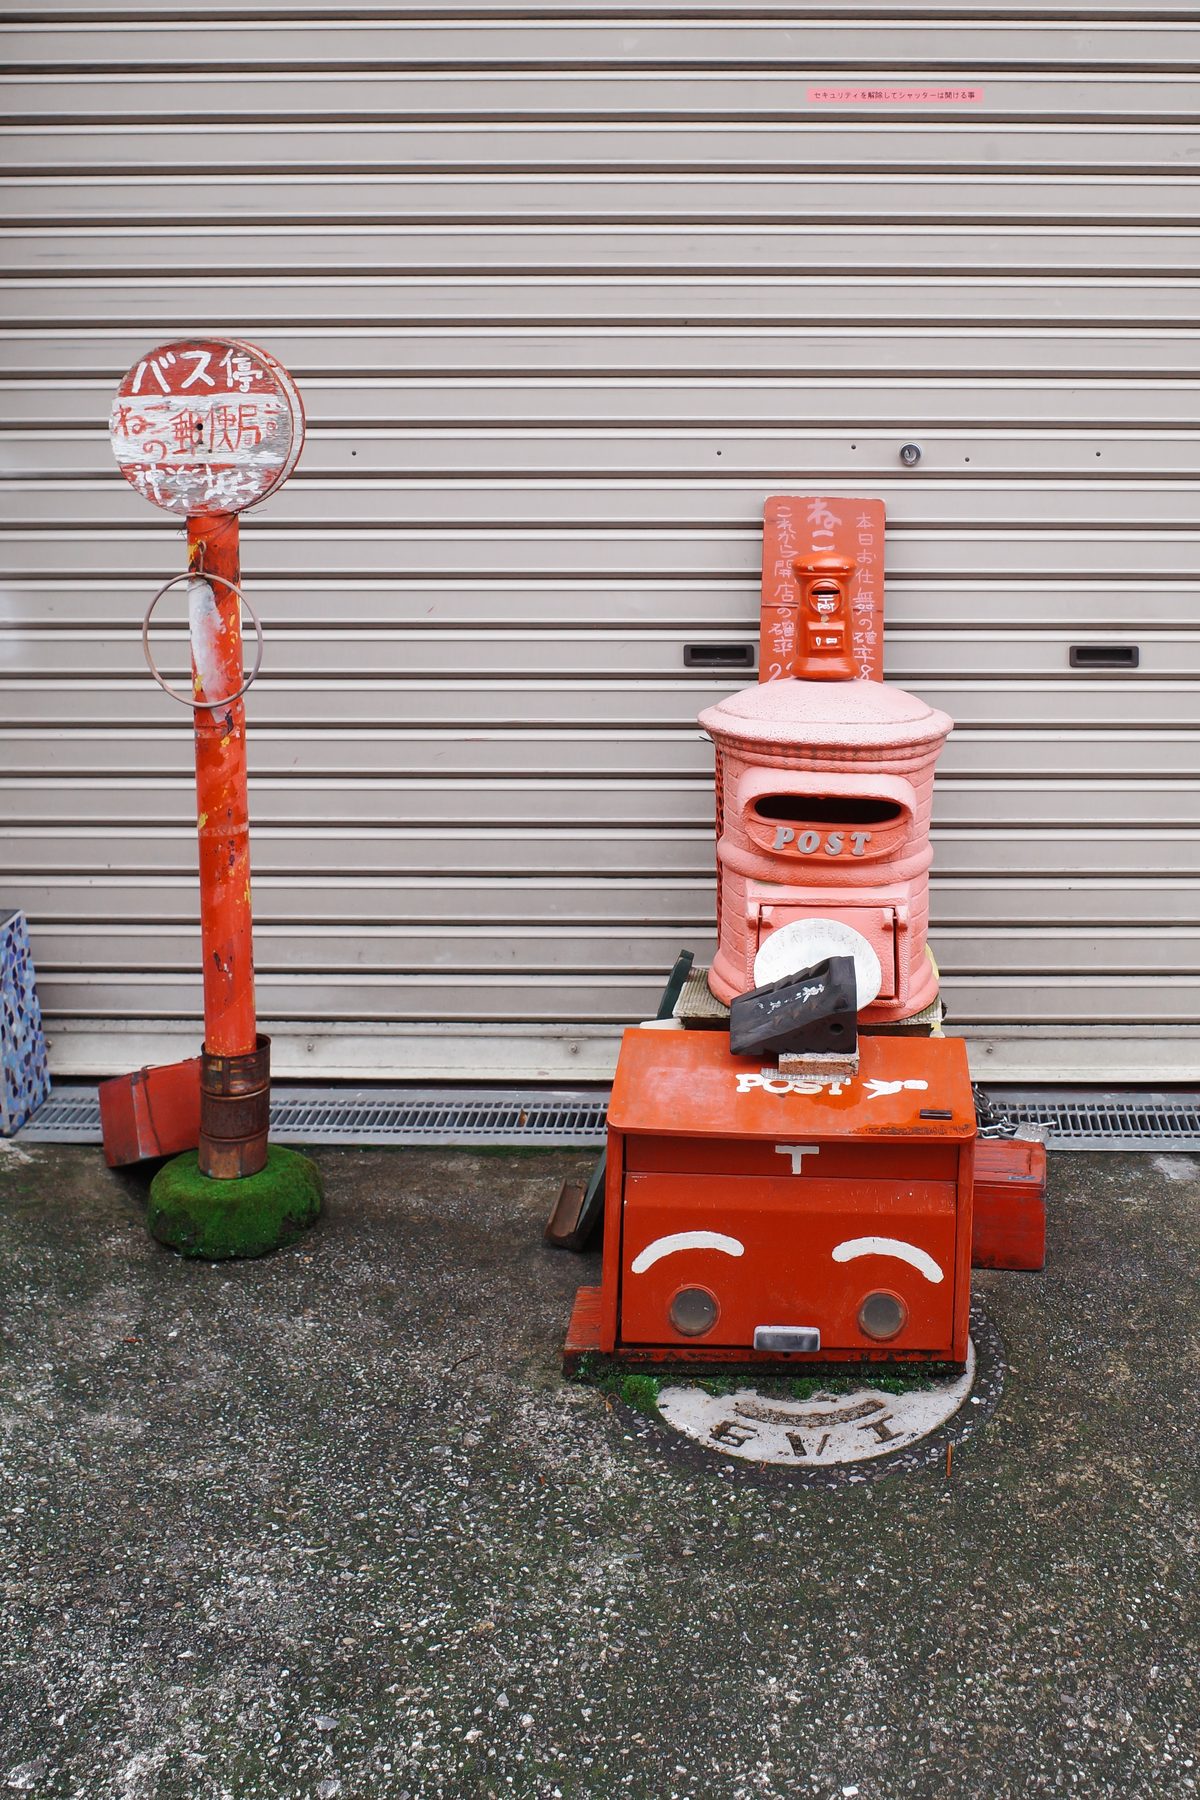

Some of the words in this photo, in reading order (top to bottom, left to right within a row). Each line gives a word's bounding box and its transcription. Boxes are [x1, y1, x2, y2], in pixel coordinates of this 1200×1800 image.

[132, 348, 263, 393] バス停
[817, 603, 835, 612] POST
[772, 826, 872, 856] POST
[735, 1073, 852, 1095] POST
